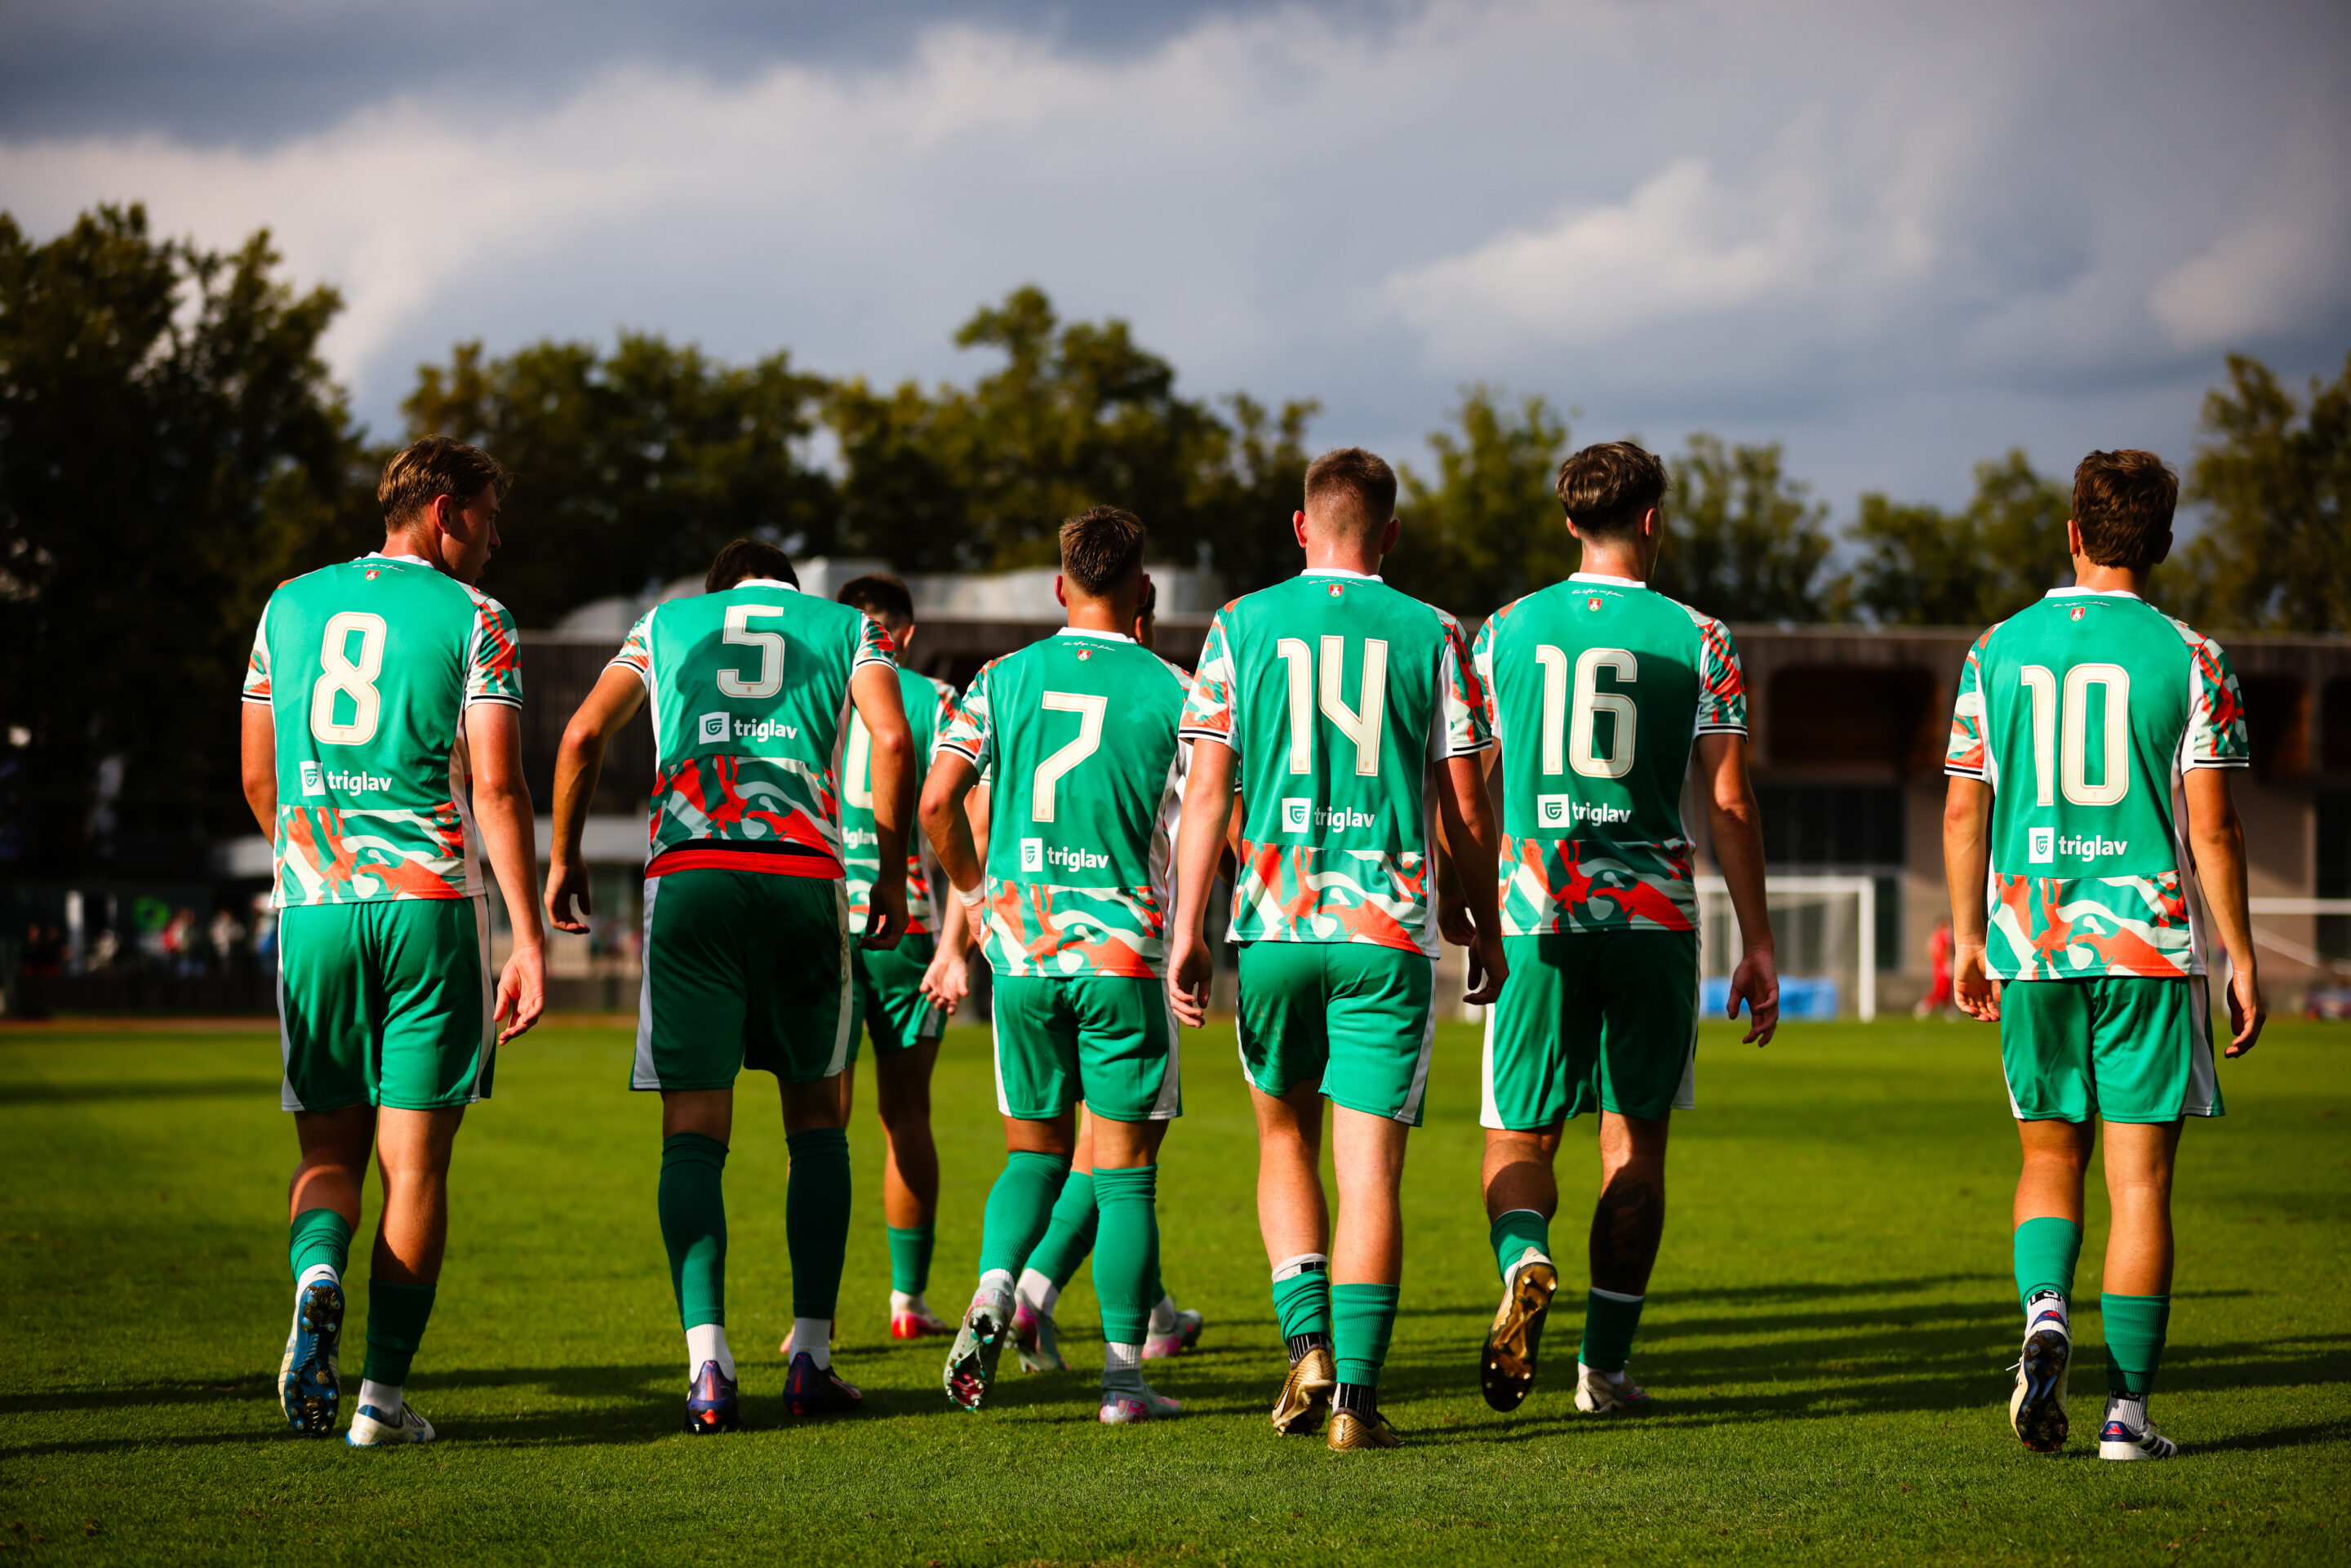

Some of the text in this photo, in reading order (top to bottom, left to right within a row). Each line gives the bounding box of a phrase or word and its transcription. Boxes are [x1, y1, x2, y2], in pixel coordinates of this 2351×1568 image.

[717, 604, 784, 698] 5
[310, 611, 387, 745] 8
[1277, 635, 1388, 776] 14
[1535, 644, 1638, 778] 16
[734, 718, 798, 743] triglav
[2020, 663, 2130, 806] 10
[1033, 691, 1108, 823] 7
[327, 771, 393, 797] triglav
[1313, 806, 1375, 833] triglav
[1571, 802, 1631, 827] triglav
[842, 826, 878, 850] iglav
[2058, 834, 2127, 862] triglav
[1047, 846, 1109, 872] triglav
